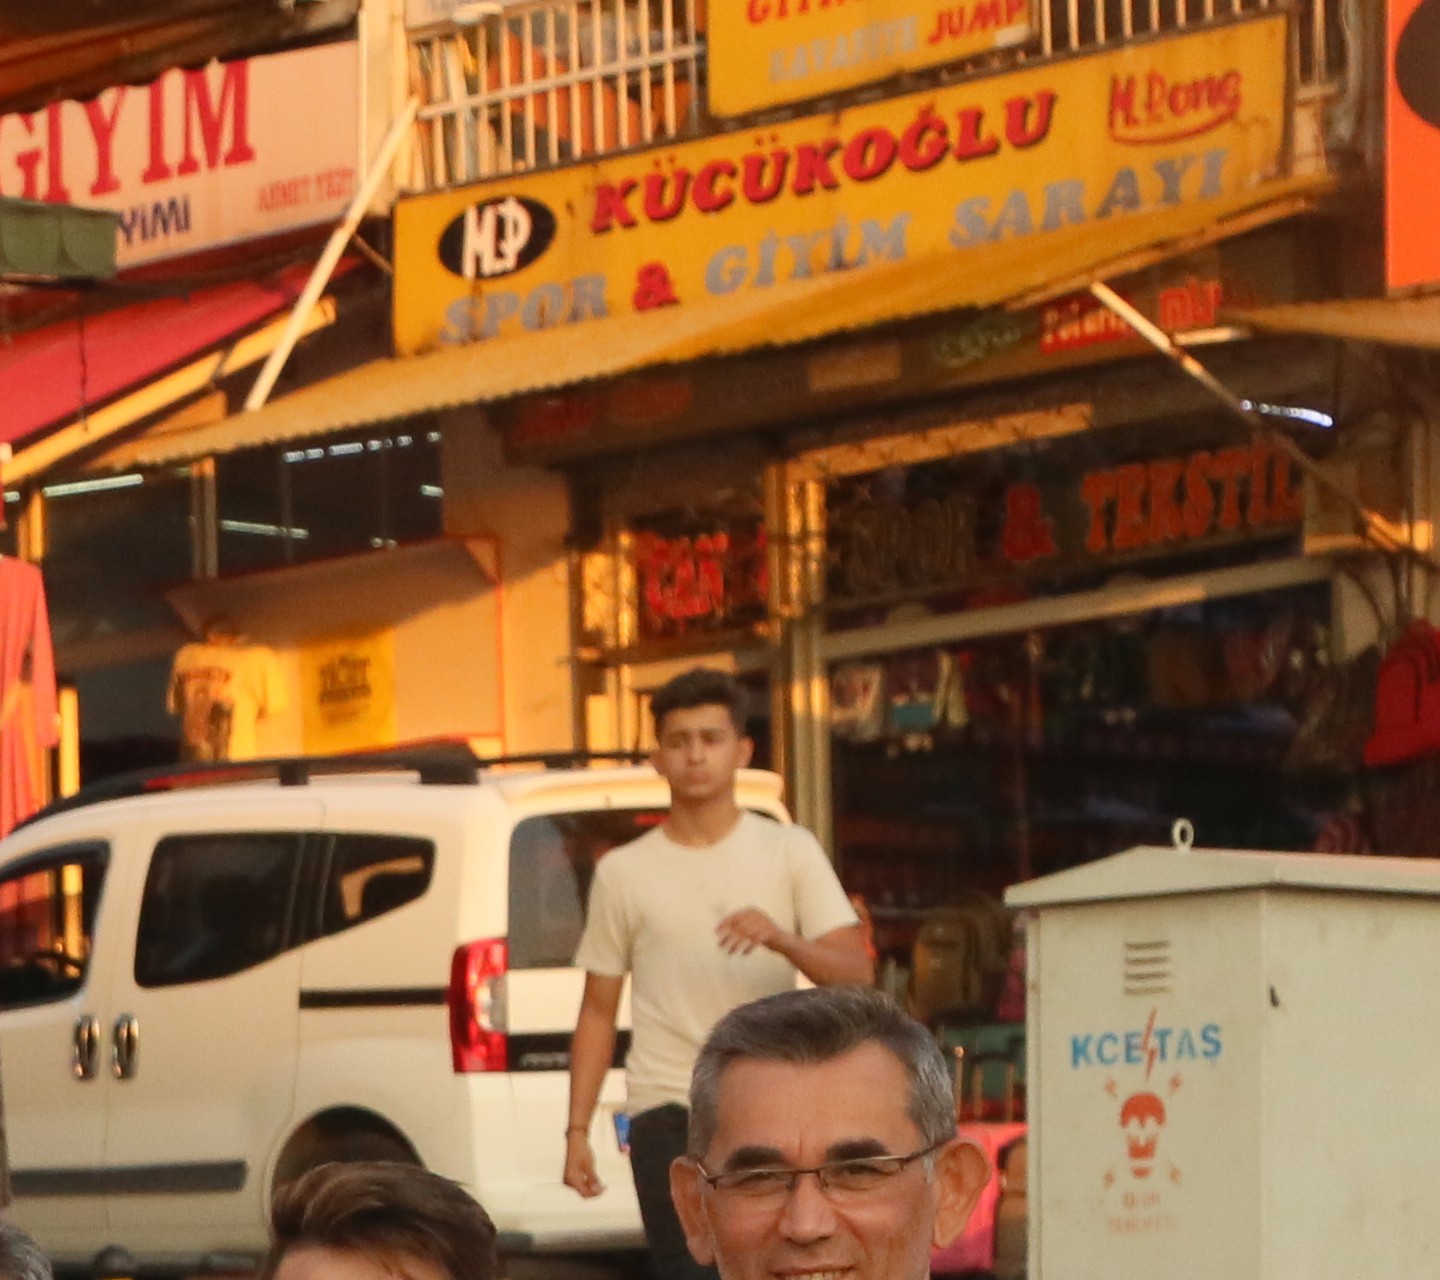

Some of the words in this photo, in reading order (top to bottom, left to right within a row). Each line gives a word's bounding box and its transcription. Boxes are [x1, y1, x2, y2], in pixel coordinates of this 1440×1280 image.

[440, 272, 609, 345] SPOR
[632, 261, 680, 314] &
[948, 147, 1231, 250] SARAYI
